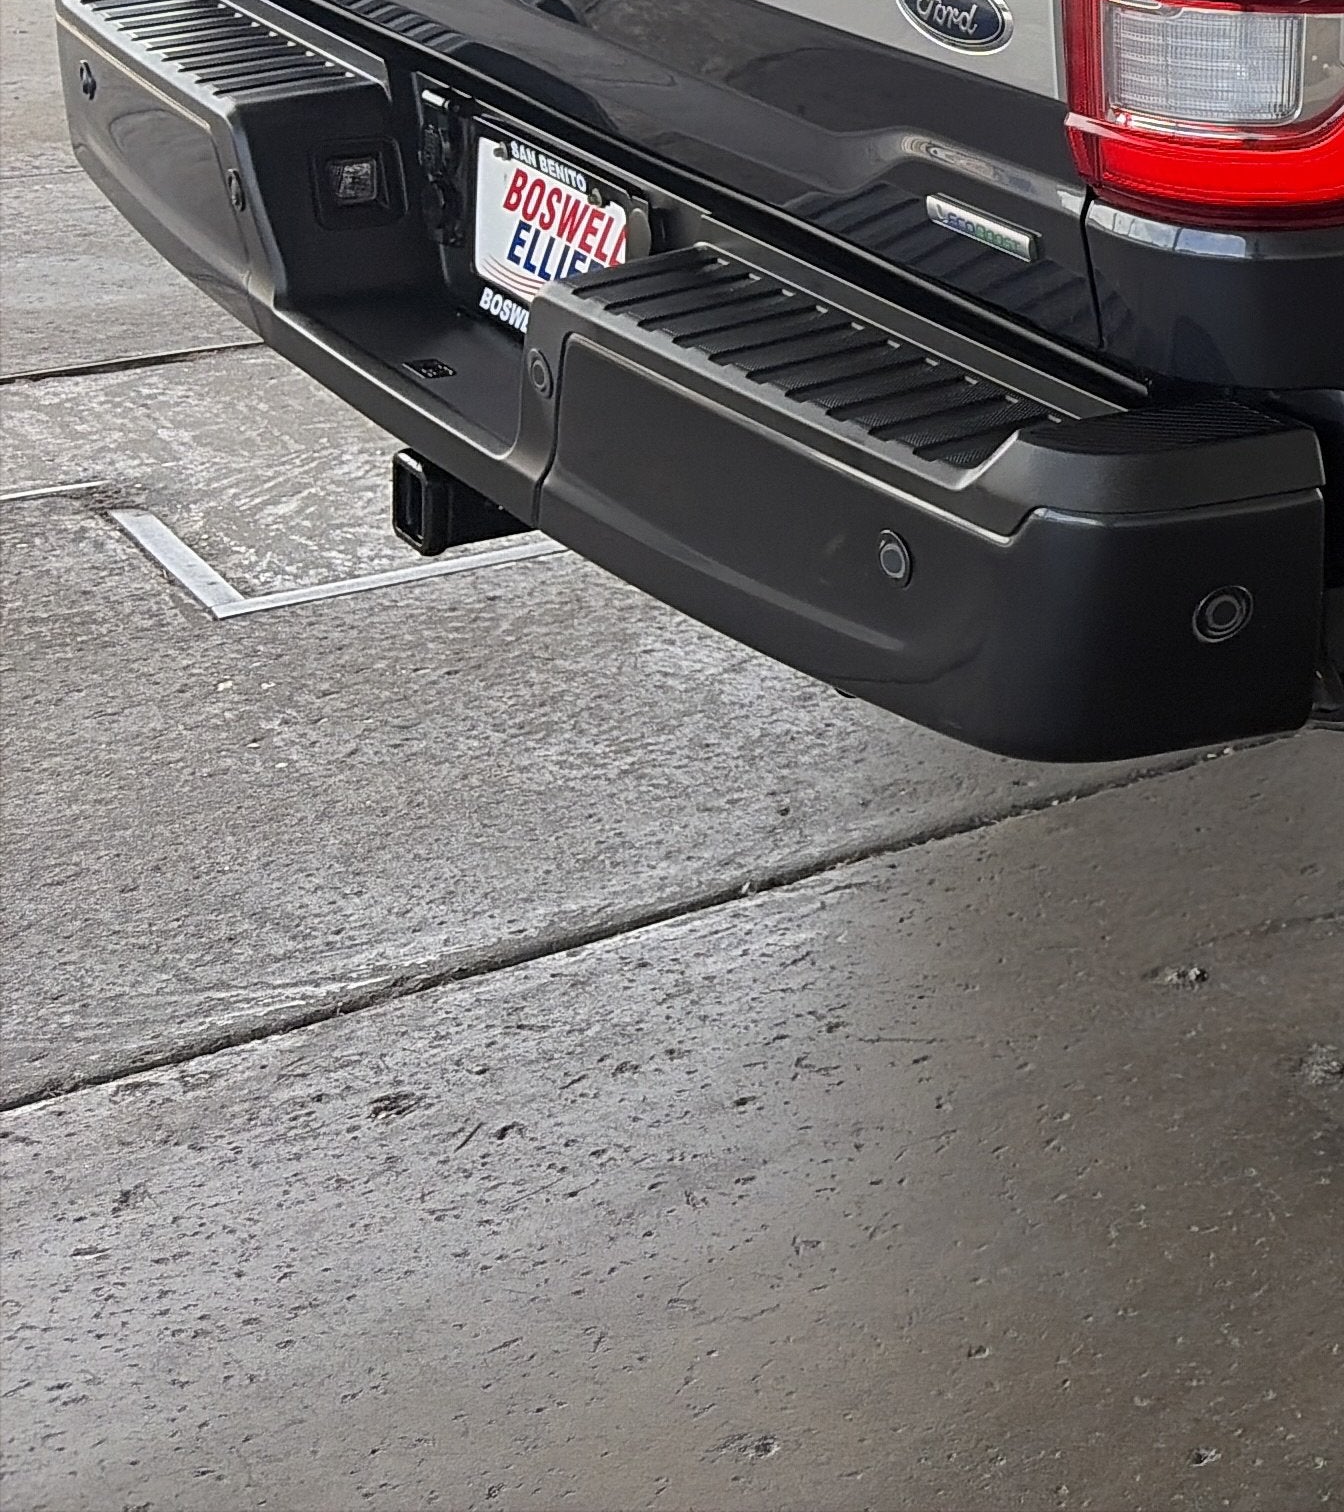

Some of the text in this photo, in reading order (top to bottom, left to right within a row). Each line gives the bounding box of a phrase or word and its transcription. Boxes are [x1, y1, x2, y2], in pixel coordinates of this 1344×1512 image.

[510, 140, 588, 192] SAN BENITO
[502, 168, 628, 269] BOSWELL
